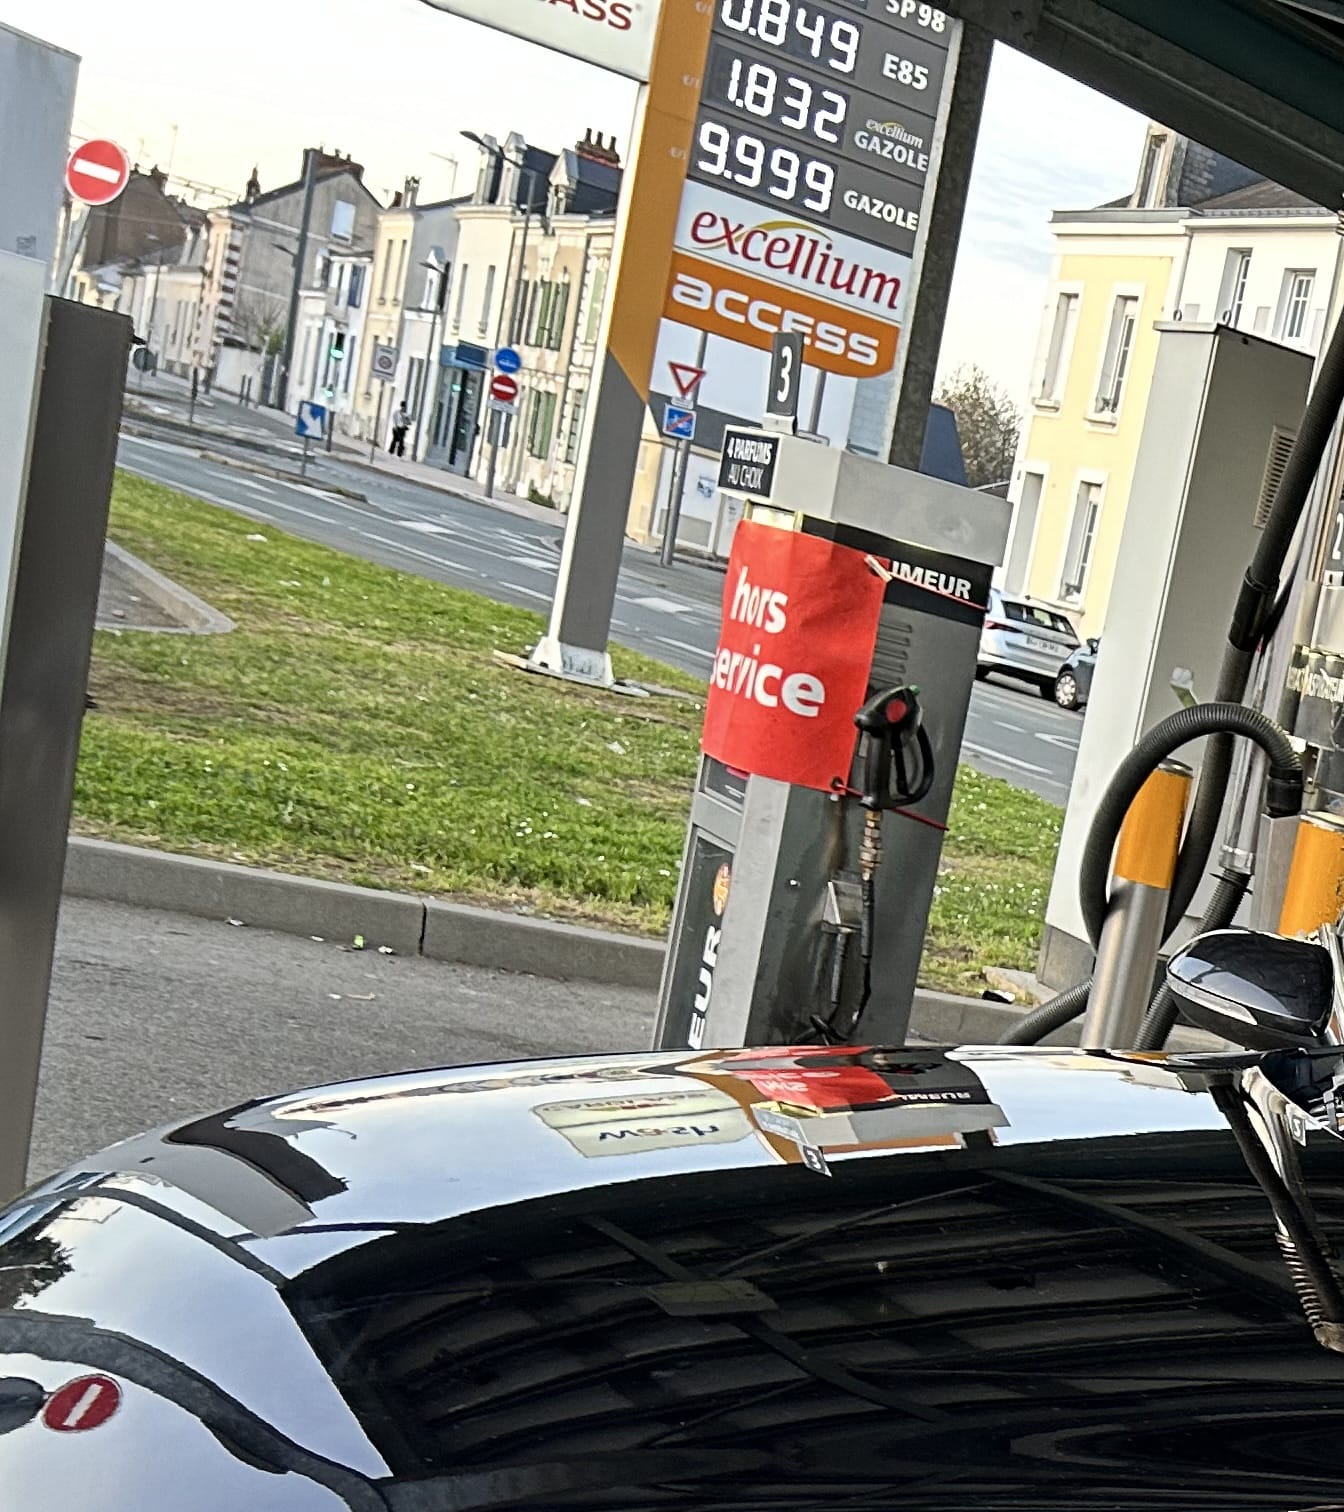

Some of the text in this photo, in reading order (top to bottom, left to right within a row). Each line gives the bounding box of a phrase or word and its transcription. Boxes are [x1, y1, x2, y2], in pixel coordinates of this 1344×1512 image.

[721, 0, 860, 73] 0.849
[918, 4, 945, 33] 98
[882, 53, 928, 90] E85
[727, 58, 847, 144] 1.832
[853, 130, 929, 172] GAZOLE
[865, 118, 924, 149] excellium
[698, 121, 835, 213] 9.999
[844, 190, 919, 231] GAZOLE
[691, 211, 902, 310] excellium
[777, 345, 793, 403] 3
[727, 437, 773, 466] 4 PARFUMS
[728, 463, 764, 490] AU CHOIX
[1332, 512, 1344, 560] 2
[730, 566, 788, 634] hors
